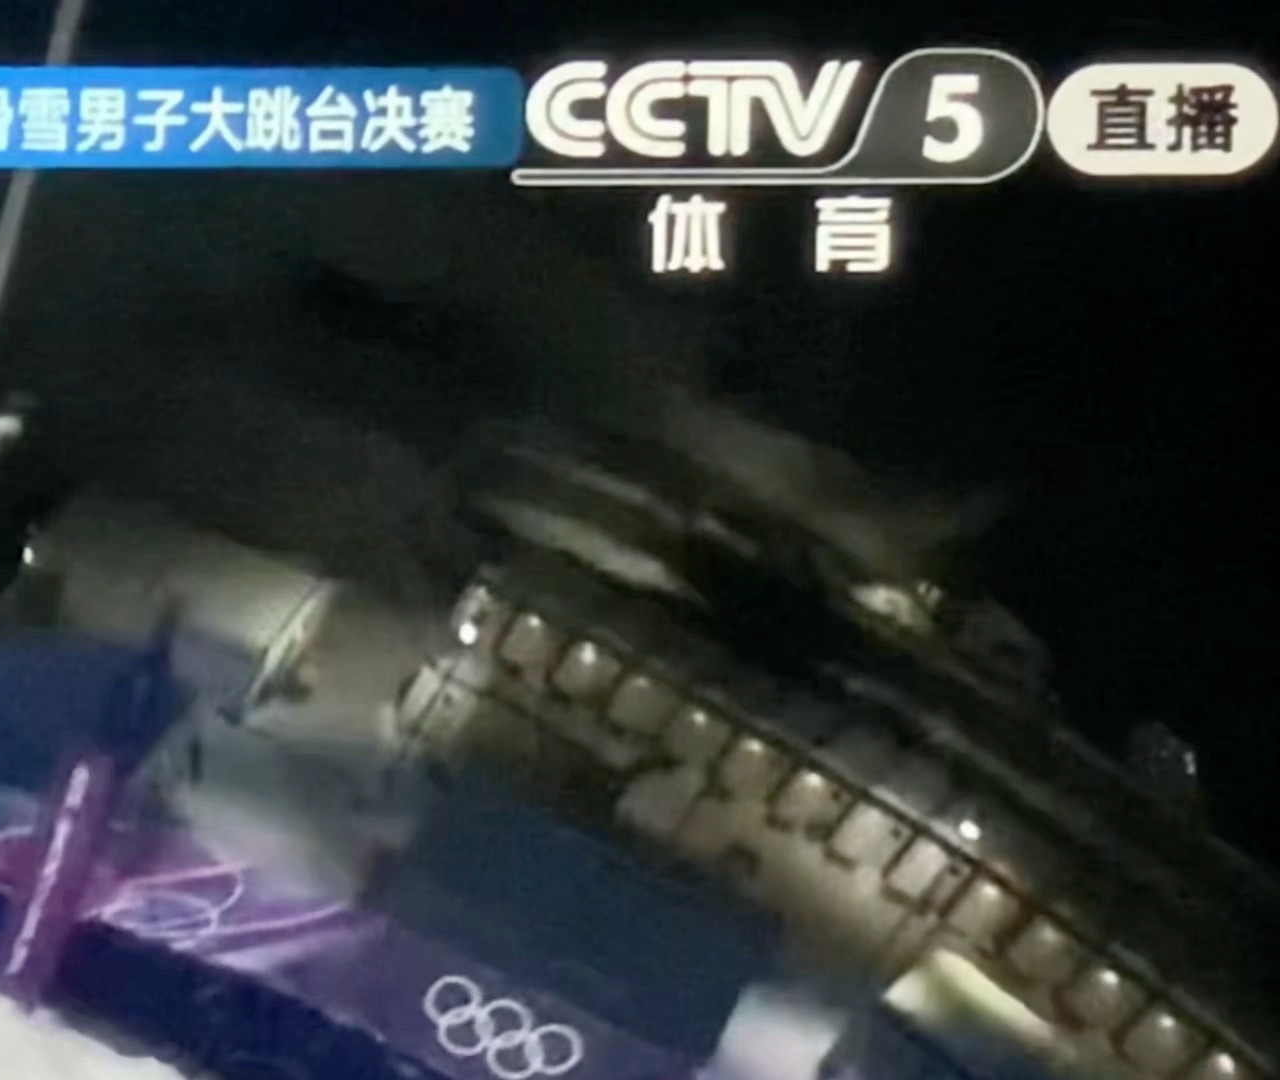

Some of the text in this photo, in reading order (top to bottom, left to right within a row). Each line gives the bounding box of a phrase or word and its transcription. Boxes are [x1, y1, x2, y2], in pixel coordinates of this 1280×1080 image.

[525, 60, 985, 163] CCTV 5
[1086, 82, 1240, 154] 直播
